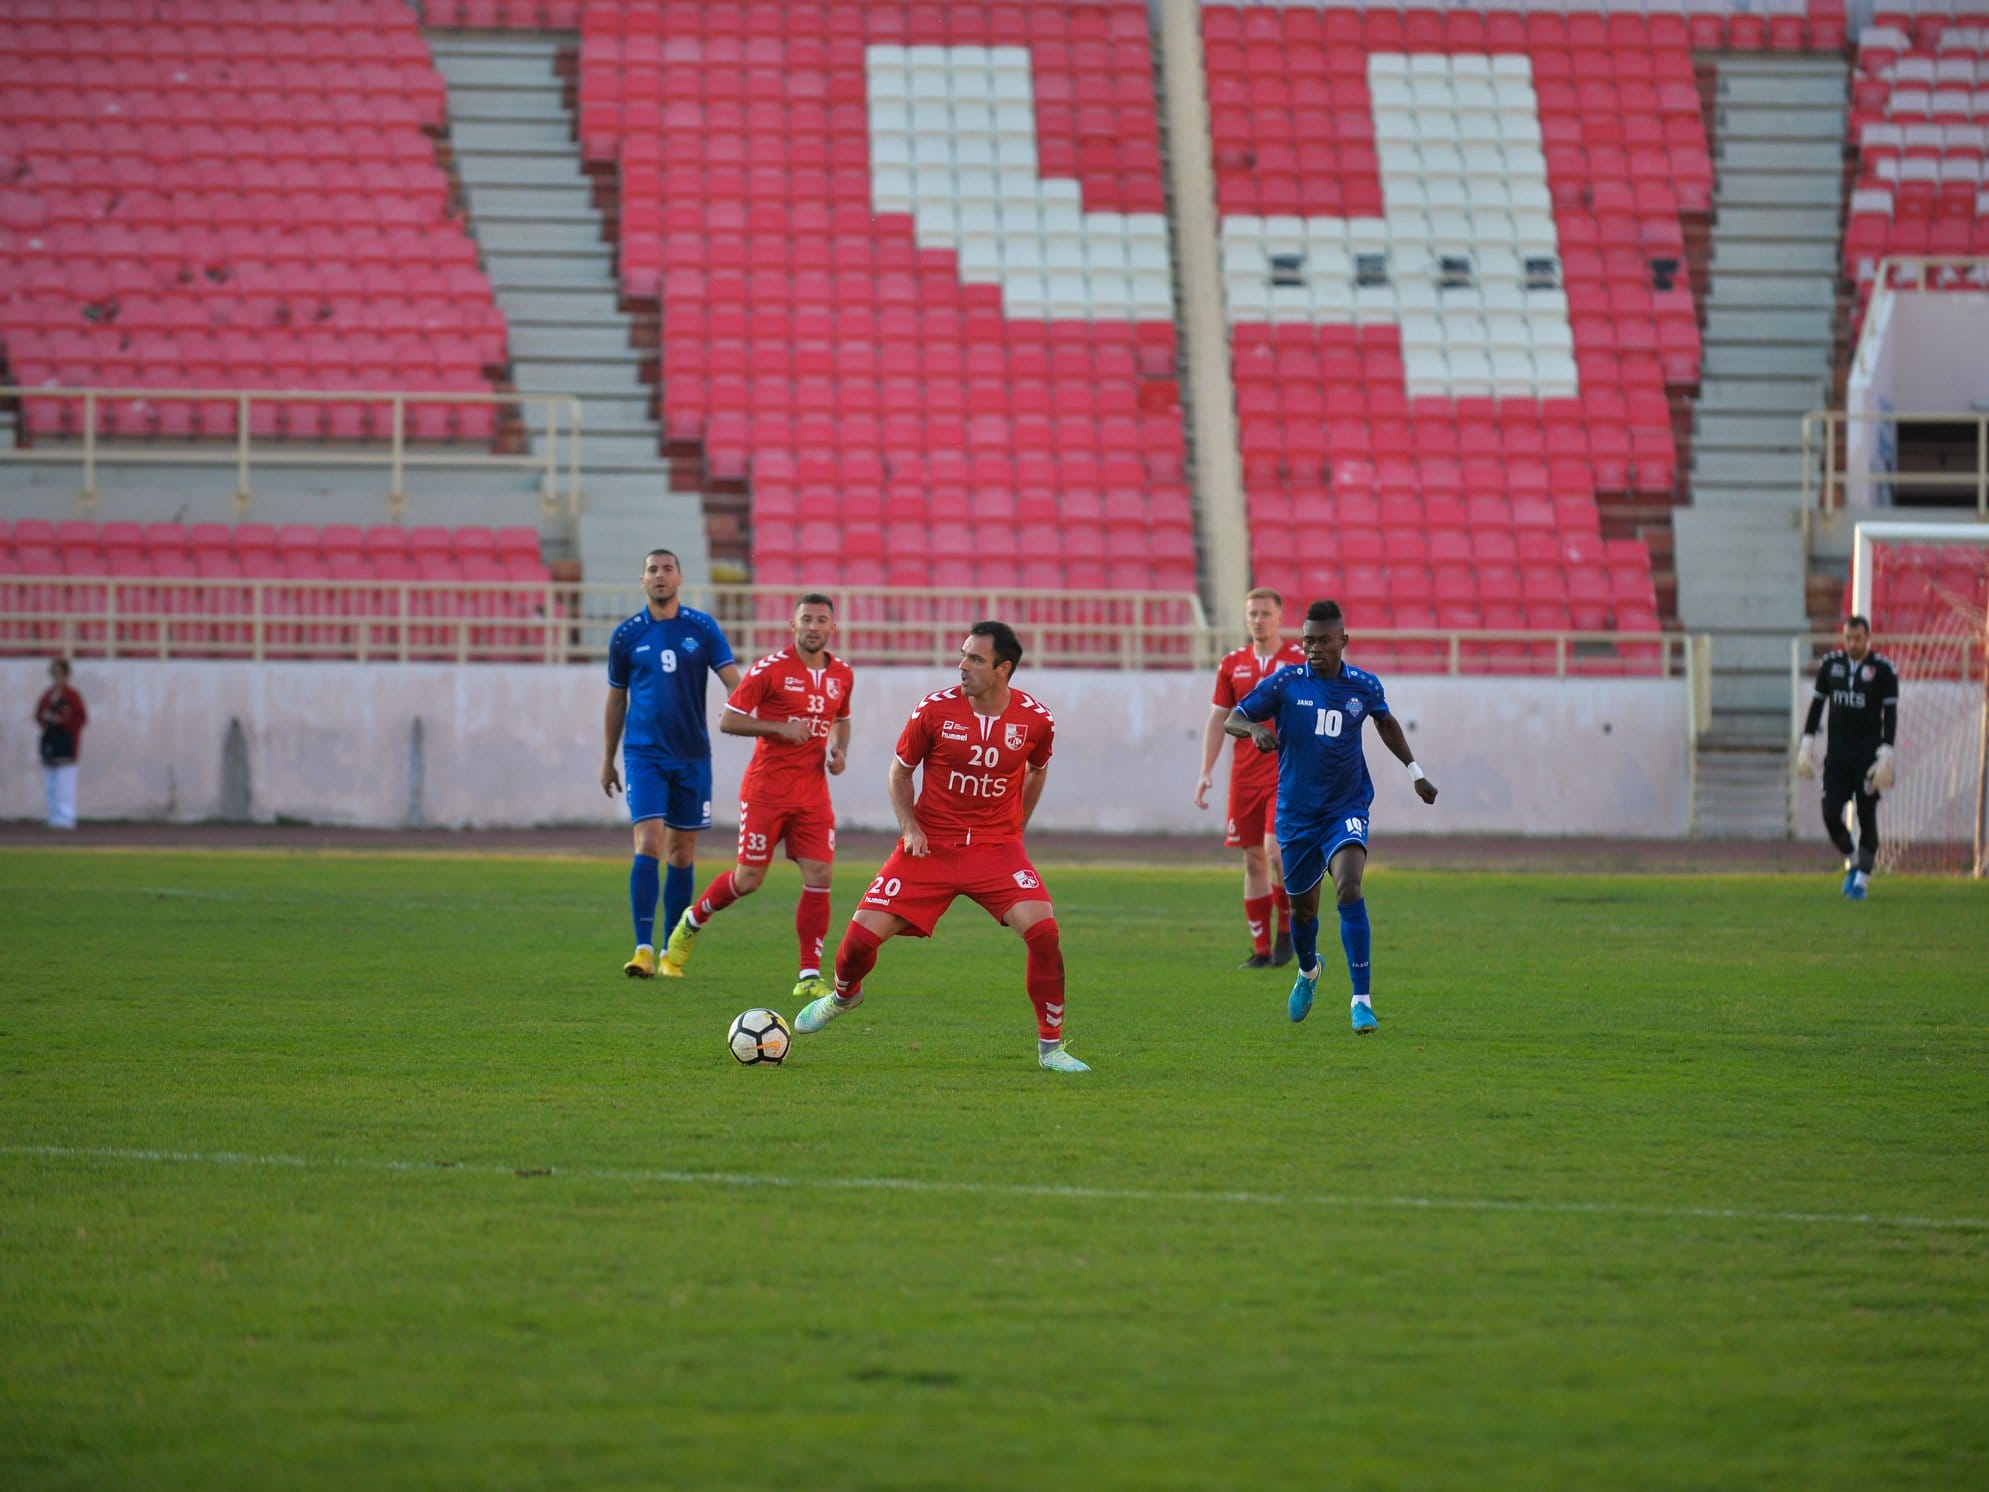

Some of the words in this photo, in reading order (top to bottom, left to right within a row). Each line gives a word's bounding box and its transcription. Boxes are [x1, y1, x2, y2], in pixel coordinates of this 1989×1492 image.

[661, 649, 677, 673] 9
[807, 694, 825, 713] 33
[1296, 698, 1314, 707] JAKO
[1314, 708, 1343, 738] 10
[941, 730, 968, 742] hummel
[967, 744, 1000, 769] 20
[948, 770, 1008, 798] mts
[1345, 817, 1363, 833] 10
[747, 831, 767, 851] 33
[868, 876, 902, 897] 20
